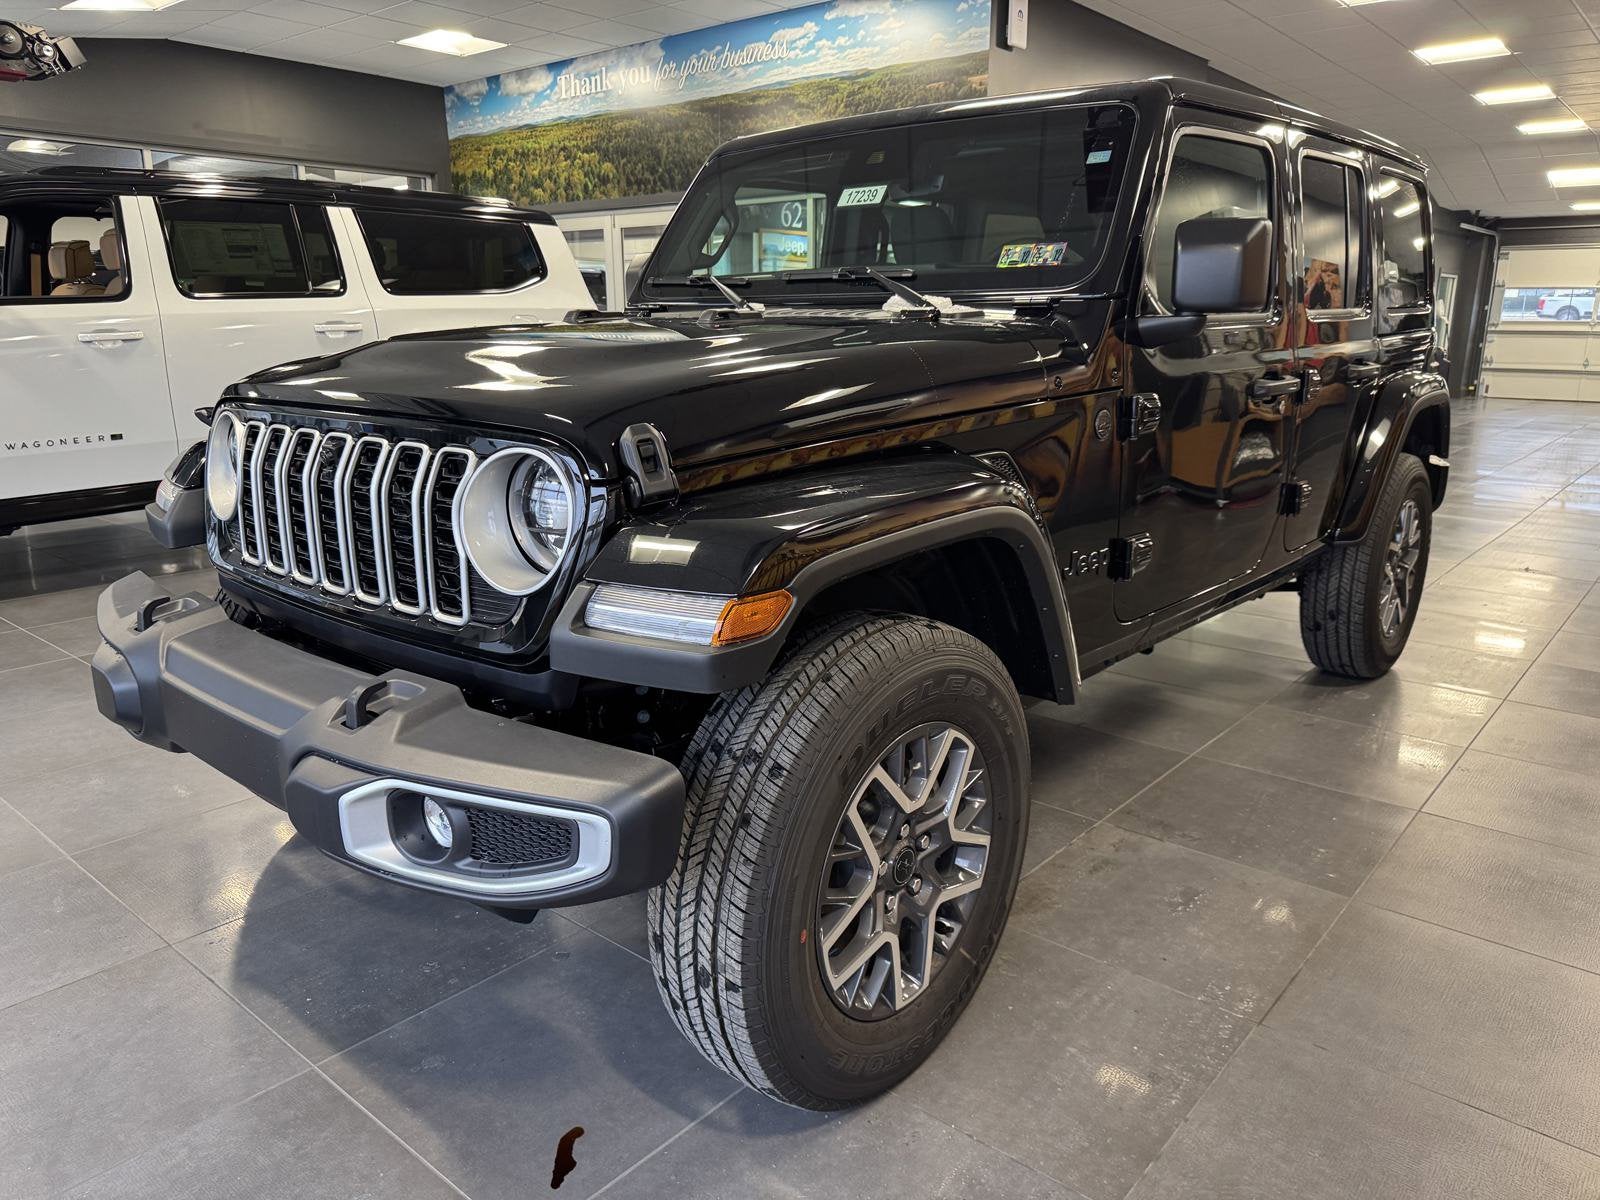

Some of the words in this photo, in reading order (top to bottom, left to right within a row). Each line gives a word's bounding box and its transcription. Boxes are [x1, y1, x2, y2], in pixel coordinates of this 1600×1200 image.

[557, 66, 613, 100] Thank
[617, 63, 651, 95] you
[653, 55, 678, 91] for
[680, 55, 719, 90] your
[720, 38, 791, 69] business
[846, 188, 880, 204] 17239
[781, 201, 803, 228] 62
[778, 237, 806, 256] Jeep
[4, 434, 106, 451] WAGONEER
